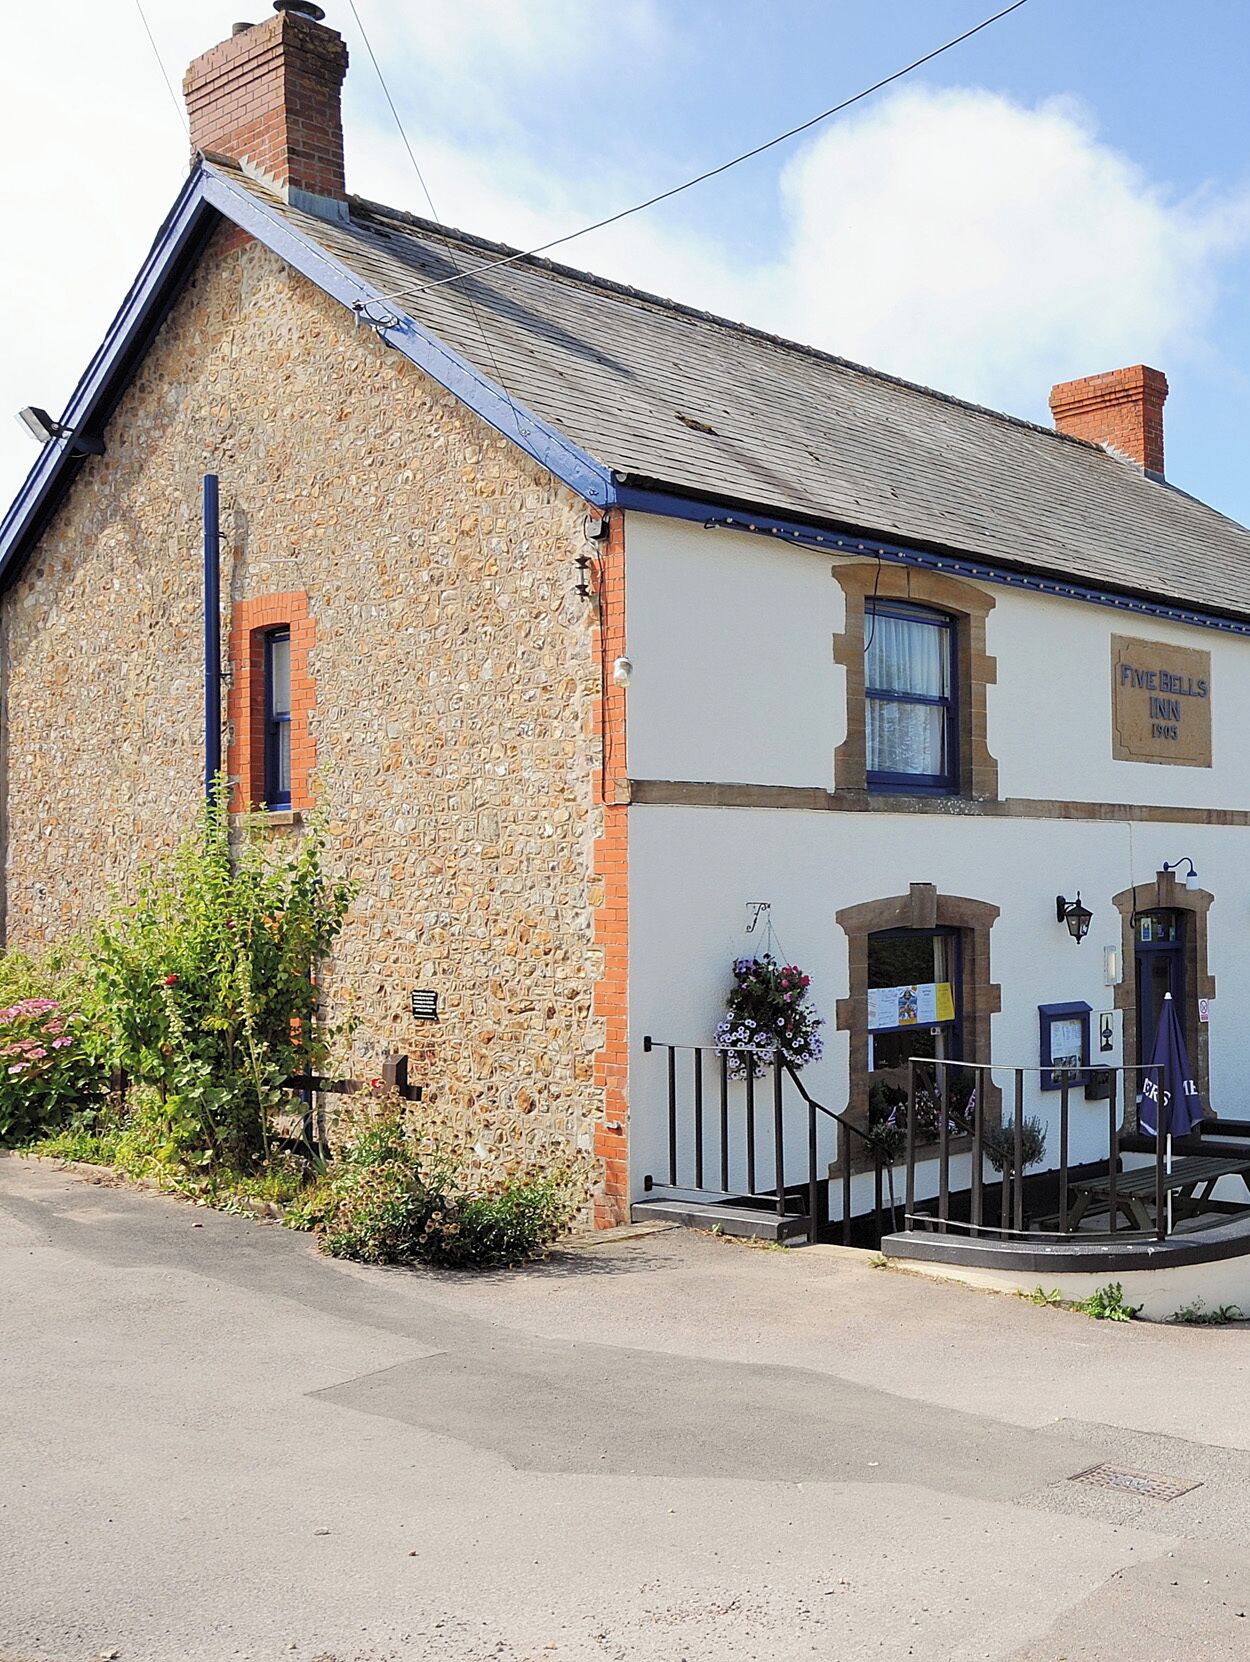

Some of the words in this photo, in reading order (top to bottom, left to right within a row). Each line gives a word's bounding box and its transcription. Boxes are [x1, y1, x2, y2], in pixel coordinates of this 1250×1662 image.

[1120, 664, 1158, 691] FIVE
[1159, 669, 1208, 698] BELLS
[1150, 696, 1182, 721] INN
[1151, 723, 1179, 741] 1905
